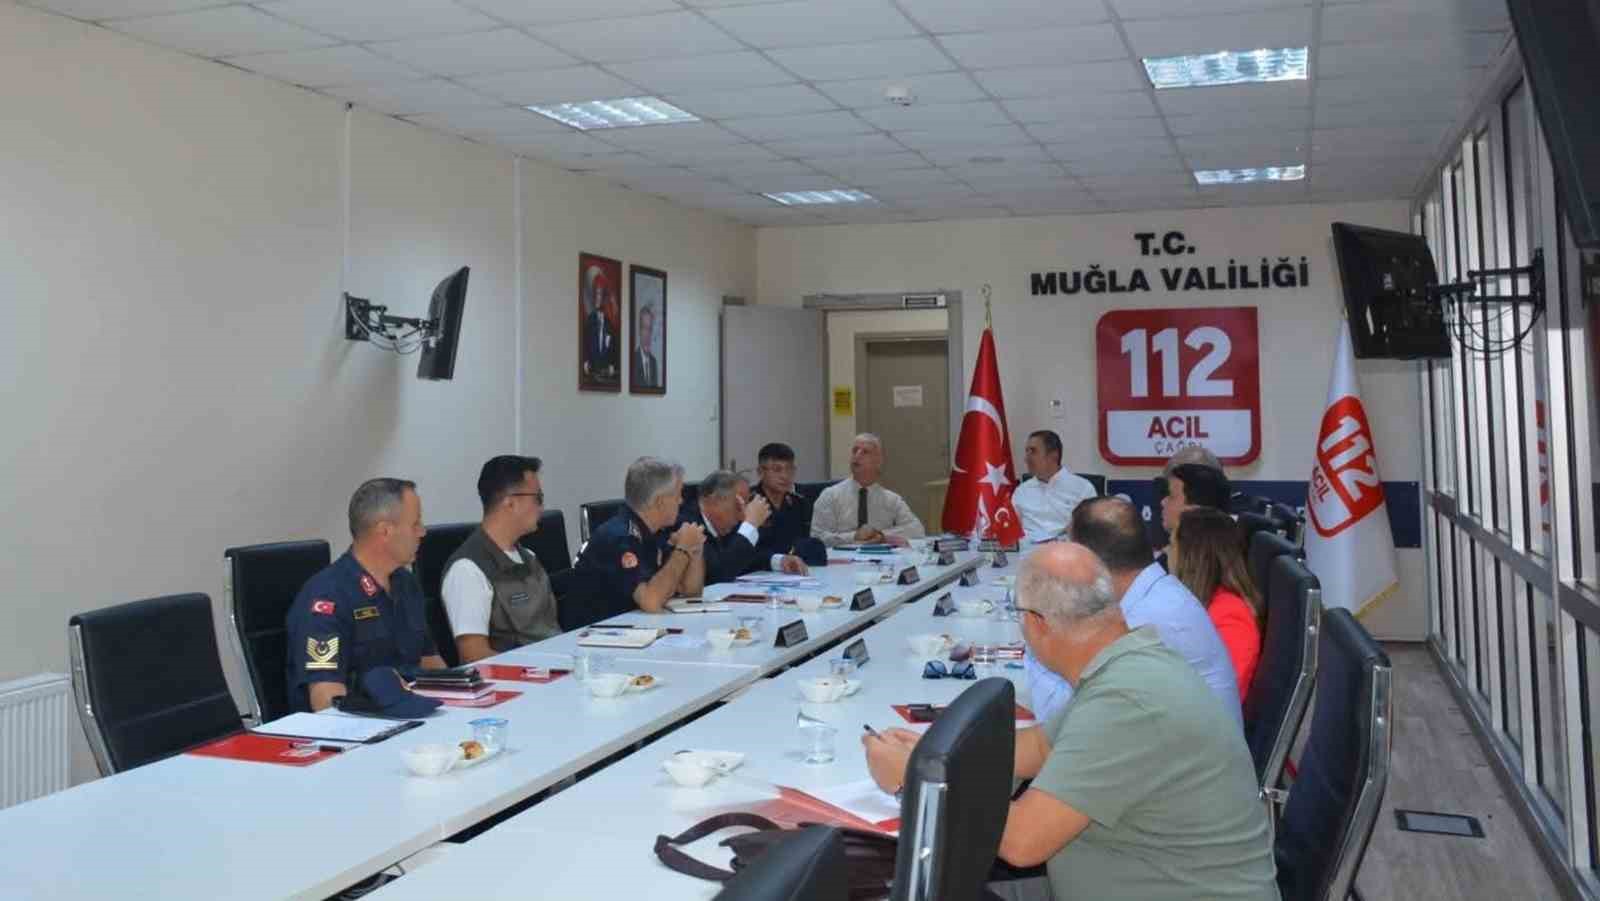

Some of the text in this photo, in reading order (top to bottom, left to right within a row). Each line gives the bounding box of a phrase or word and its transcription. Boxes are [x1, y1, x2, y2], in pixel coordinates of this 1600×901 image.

[1134, 231, 1196, 256] T.C.
[1030, 256, 1309, 296] MUĞLA VALİLİĞİ
[1120, 326, 1234, 398] 112
[1320, 415, 1379, 502] 112
